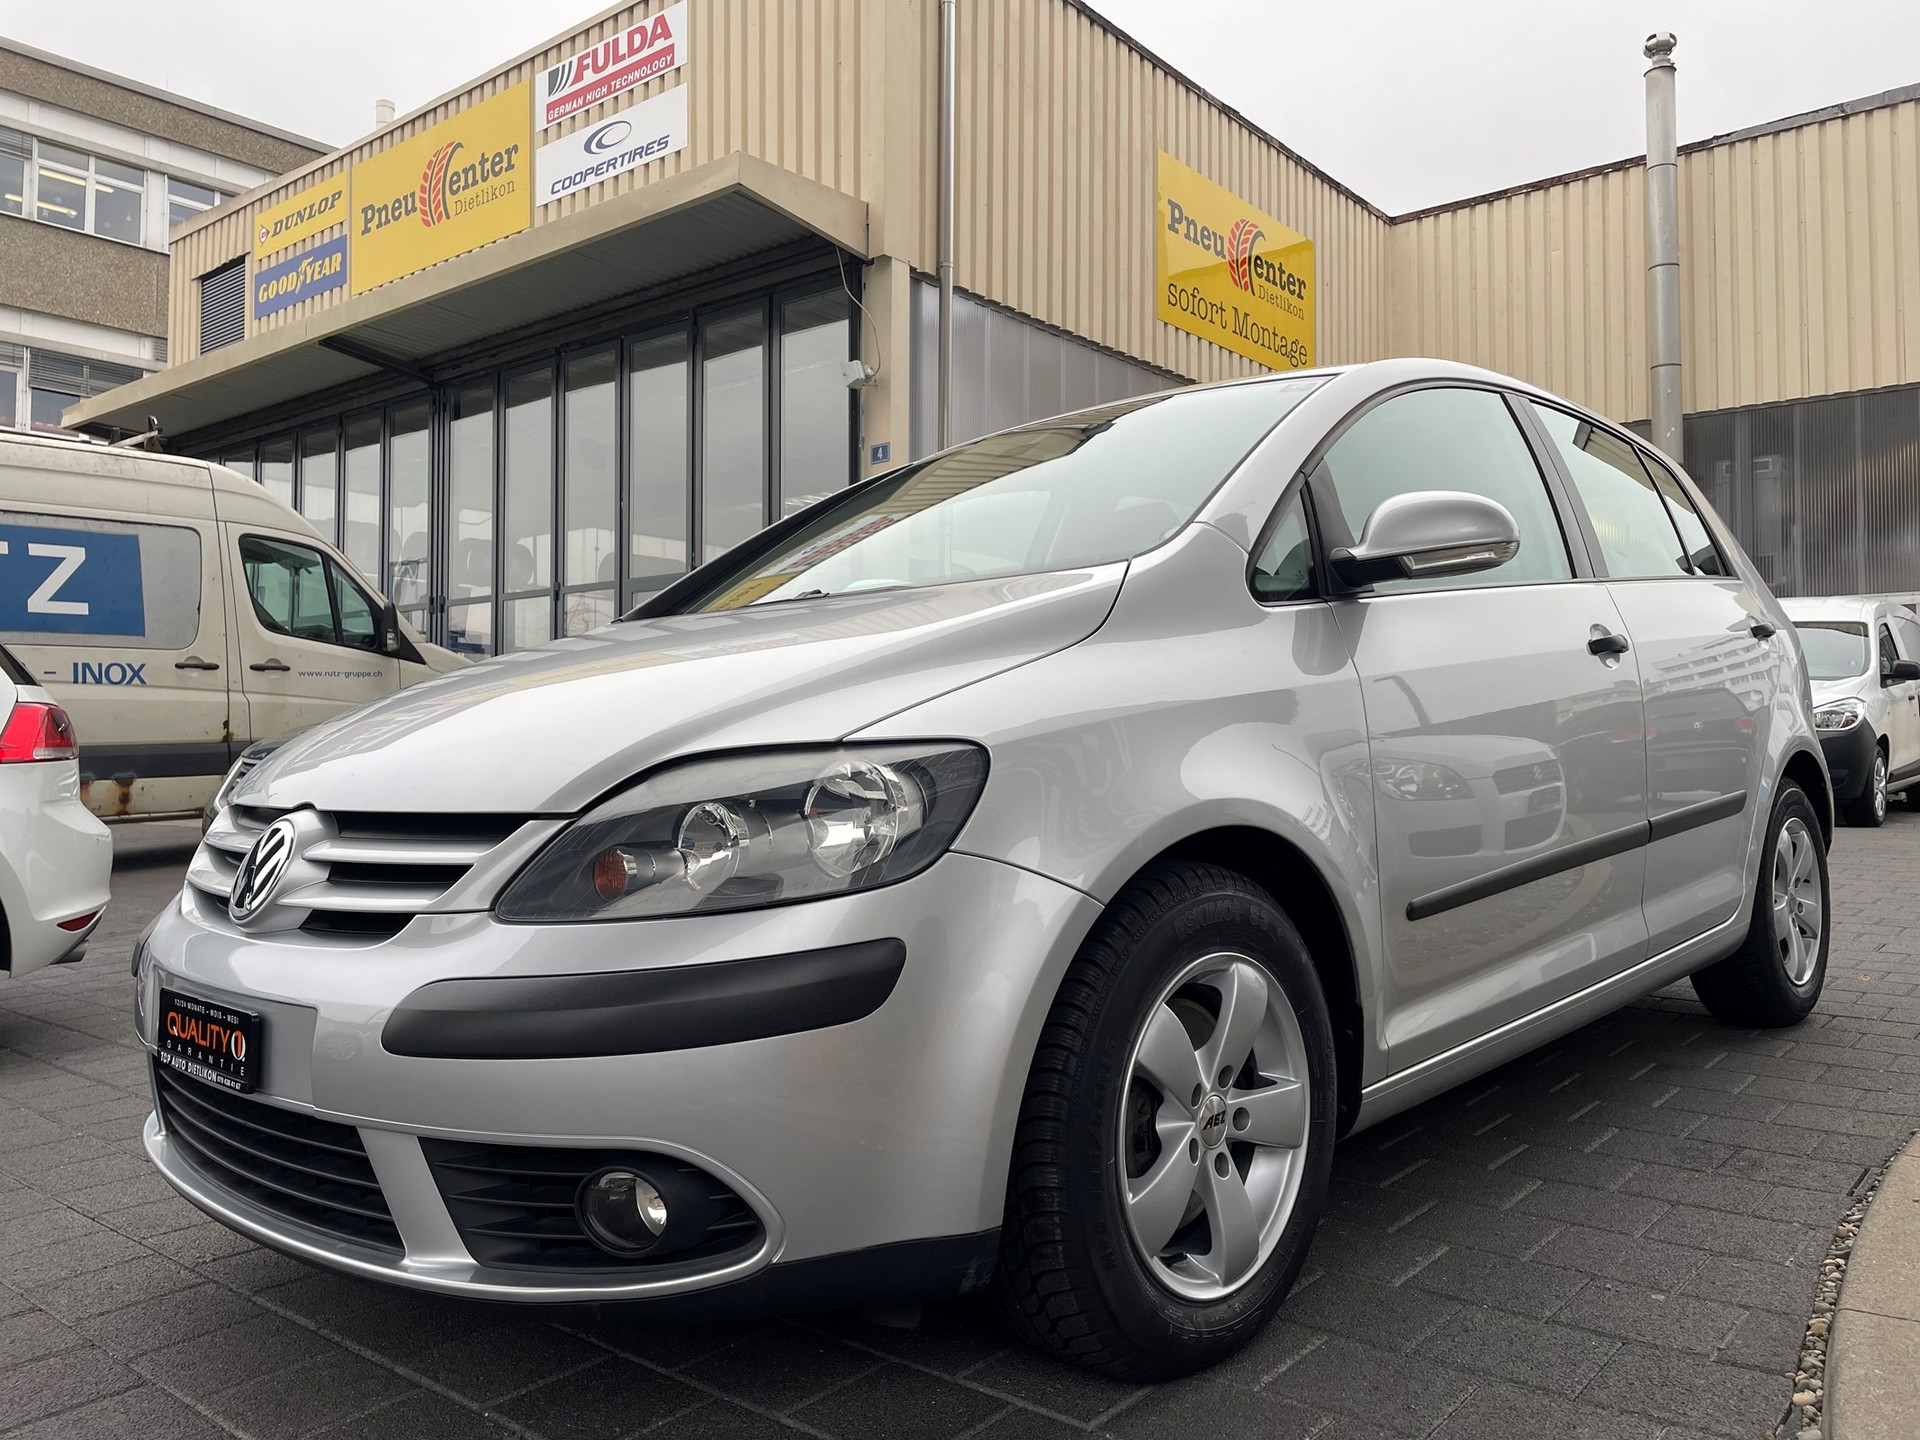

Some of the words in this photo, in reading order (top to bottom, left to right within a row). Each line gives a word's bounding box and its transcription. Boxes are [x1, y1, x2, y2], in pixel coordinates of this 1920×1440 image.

[568, 13, 673, 87] FULDA
[548, 97, 584, 121] GERMAN
[586, 86, 608, 102] HIGH
[610, 54, 673, 92] TECHNOLOGY
[551, 134, 670, 196] COOPERTIRES
[271, 190, 342, 238] DUNLOP
[361, 191, 418, 236] Pneu
[454, 180, 515, 216] Dietlikon
[1167, 198, 1227, 260] Pneu
[258, 252, 342, 303] GOODYEAR
[1258, 284, 1304, 320] Dietlikon
[1232, 306, 1307, 367] Montage
[877, 447, 884, 460] 4
[72, 662, 147, 685] INOX
[298, 670, 383, 679] www.rutz-gruppe.ch
[167, 1011, 231, 1053] QUALITY
[161, 1051, 171, 1064] TOP
[171, 1056, 186, 1070] AUTO
[188, 1062, 217, 1083] DIETLIKON
[1202, 1110, 1226, 1131] AEZ
